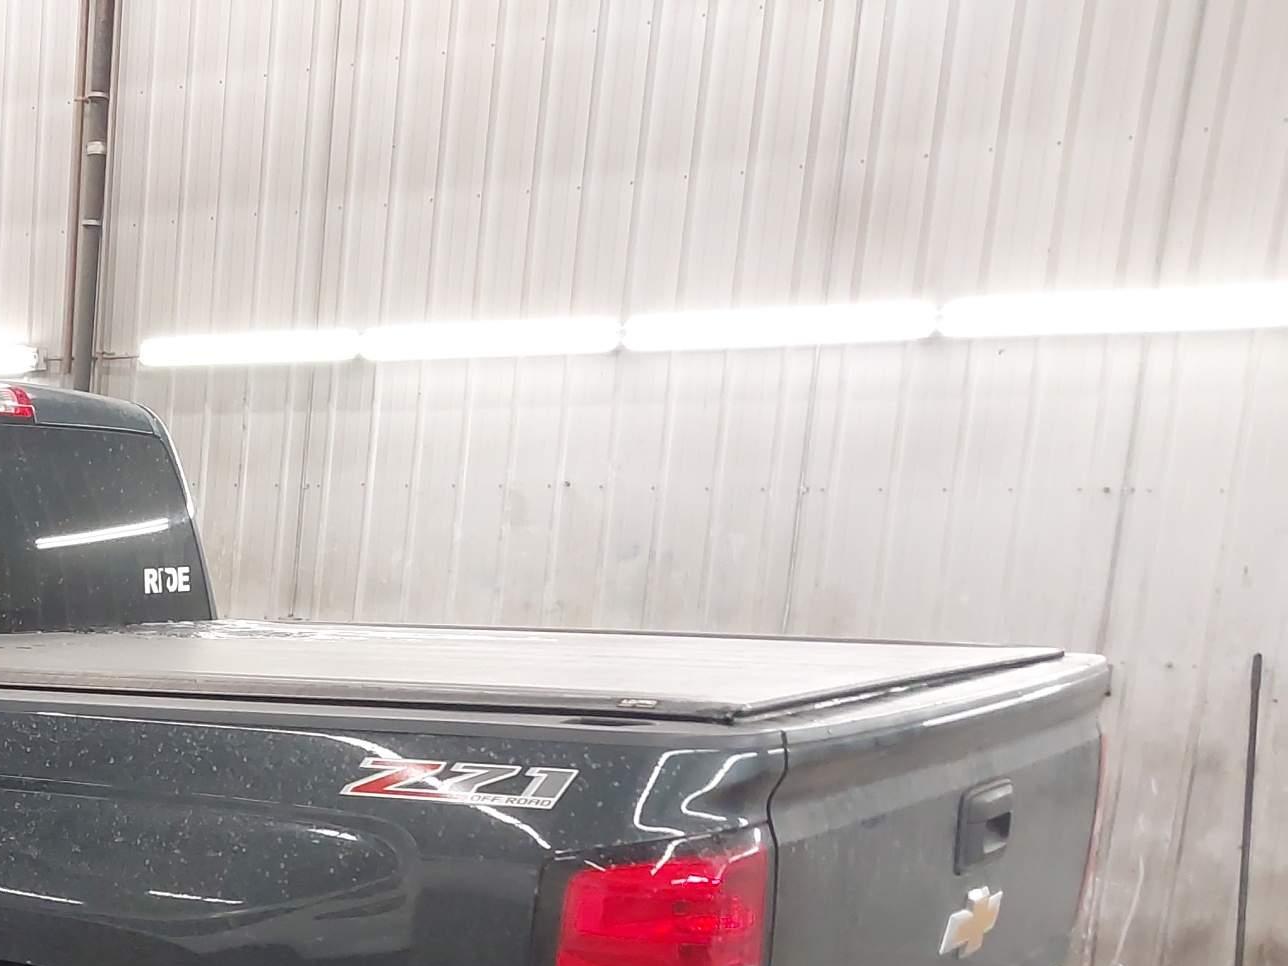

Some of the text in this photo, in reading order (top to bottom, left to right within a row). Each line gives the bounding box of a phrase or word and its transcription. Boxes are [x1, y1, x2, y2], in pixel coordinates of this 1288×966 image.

[143, 566, 191, 594] RIDE
[339, 756, 580, 803] Z71
[469, 794, 552, 807] OFF ROAD
